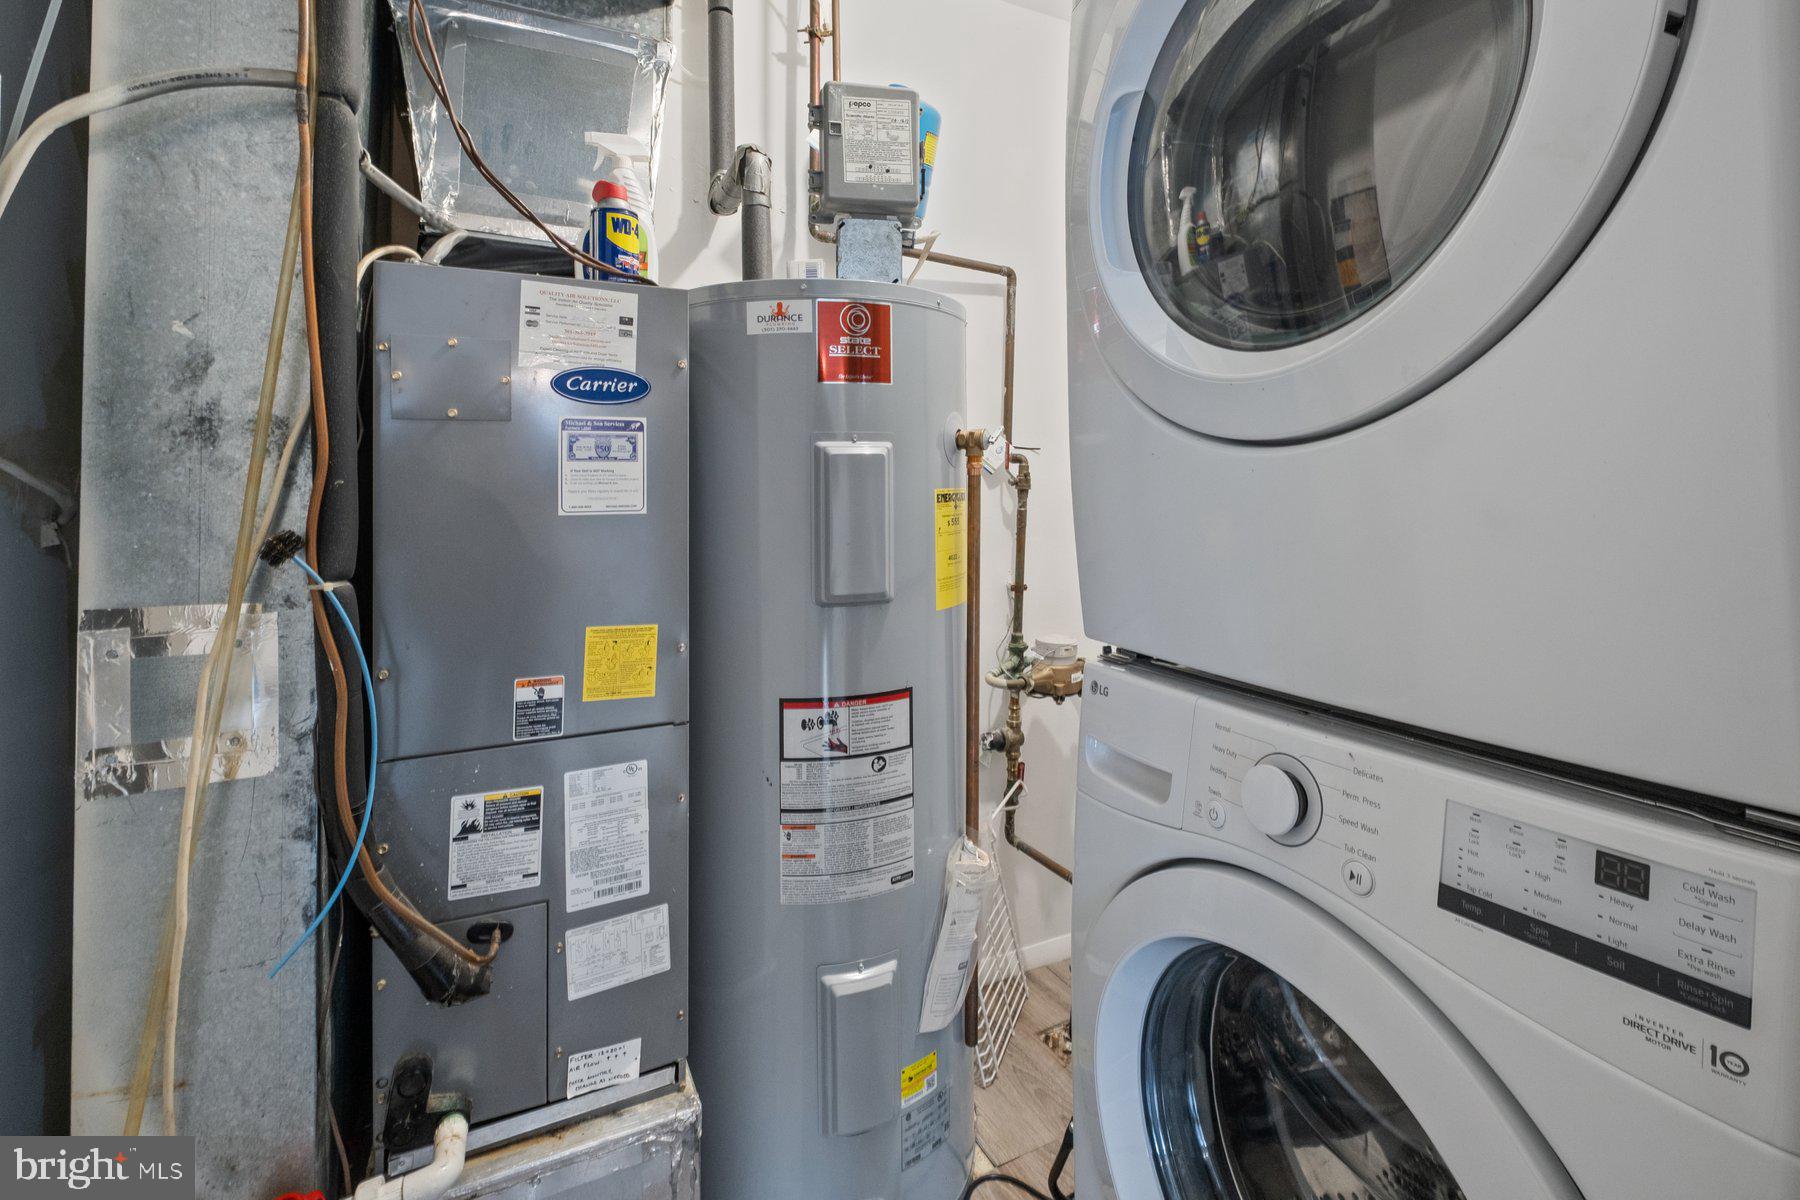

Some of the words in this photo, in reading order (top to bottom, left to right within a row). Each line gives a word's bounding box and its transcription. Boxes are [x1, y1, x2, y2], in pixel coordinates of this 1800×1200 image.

[756, 313, 803, 323] DURANCE
[839, 336, 872, 345] state
[829, 345, 881, 356] SELECT
[566, 376, 638, 393] Carrier
[1226, 748, 1237, 759] Duty
[1353, 767, 1384, 783] Delicates
[1362, 796, 1381, 809] Press
[1339, 814, 1359, 829] Speed
[1361, 822, 1379, 835] Wash
[1344, 843, 1355, 854] Tub
[1357, 848, 1377, 862] Clean
[1467, 849, 1479, 858] Hot
[1466, 865, 1485, 878] Warm
[1534, 870, 1551, 882] High
[1466, 884, 1477, 895] Tap
[1478, 888, 1493, 900] Cold
[1533, 889, 1562, 905] Medium
[1682, 881, 1705, 896] Cold
[1708, 889, 1736, 906] Wash
[1609, 895, 1634, 911] Heavy
[1532, 908, 1547, 919] Low
[1530, 922, 1549, 938] Spin
[1608, 915, 1638, 932] Normal
[1678, 917, 1706, 936] Delay
[1709, 928, 1737, 945] Wash
[1607, 935, 1628, 950] Light
[1606, 955, 1625, 971] Soil
[1677, 948, 1704, 966] Extra
[1707, 959, 1736, 977] Rinse
[1634, 1013, 1684, 1038] INVERTER
[1622, 1016, 1661, 1039] DIRECT
[1662, 1033, 1697, 1055] DRIVE
[1645, 1036, 1672, 1051] MOTOR
[583, 1060, 600, 1068] FLOW
[1710, 1044, 1750, 1077] 10
[1727, 1059, 1742, 1069] YEAR
[1711, 1068, 1747, 1087] WARRANTY
